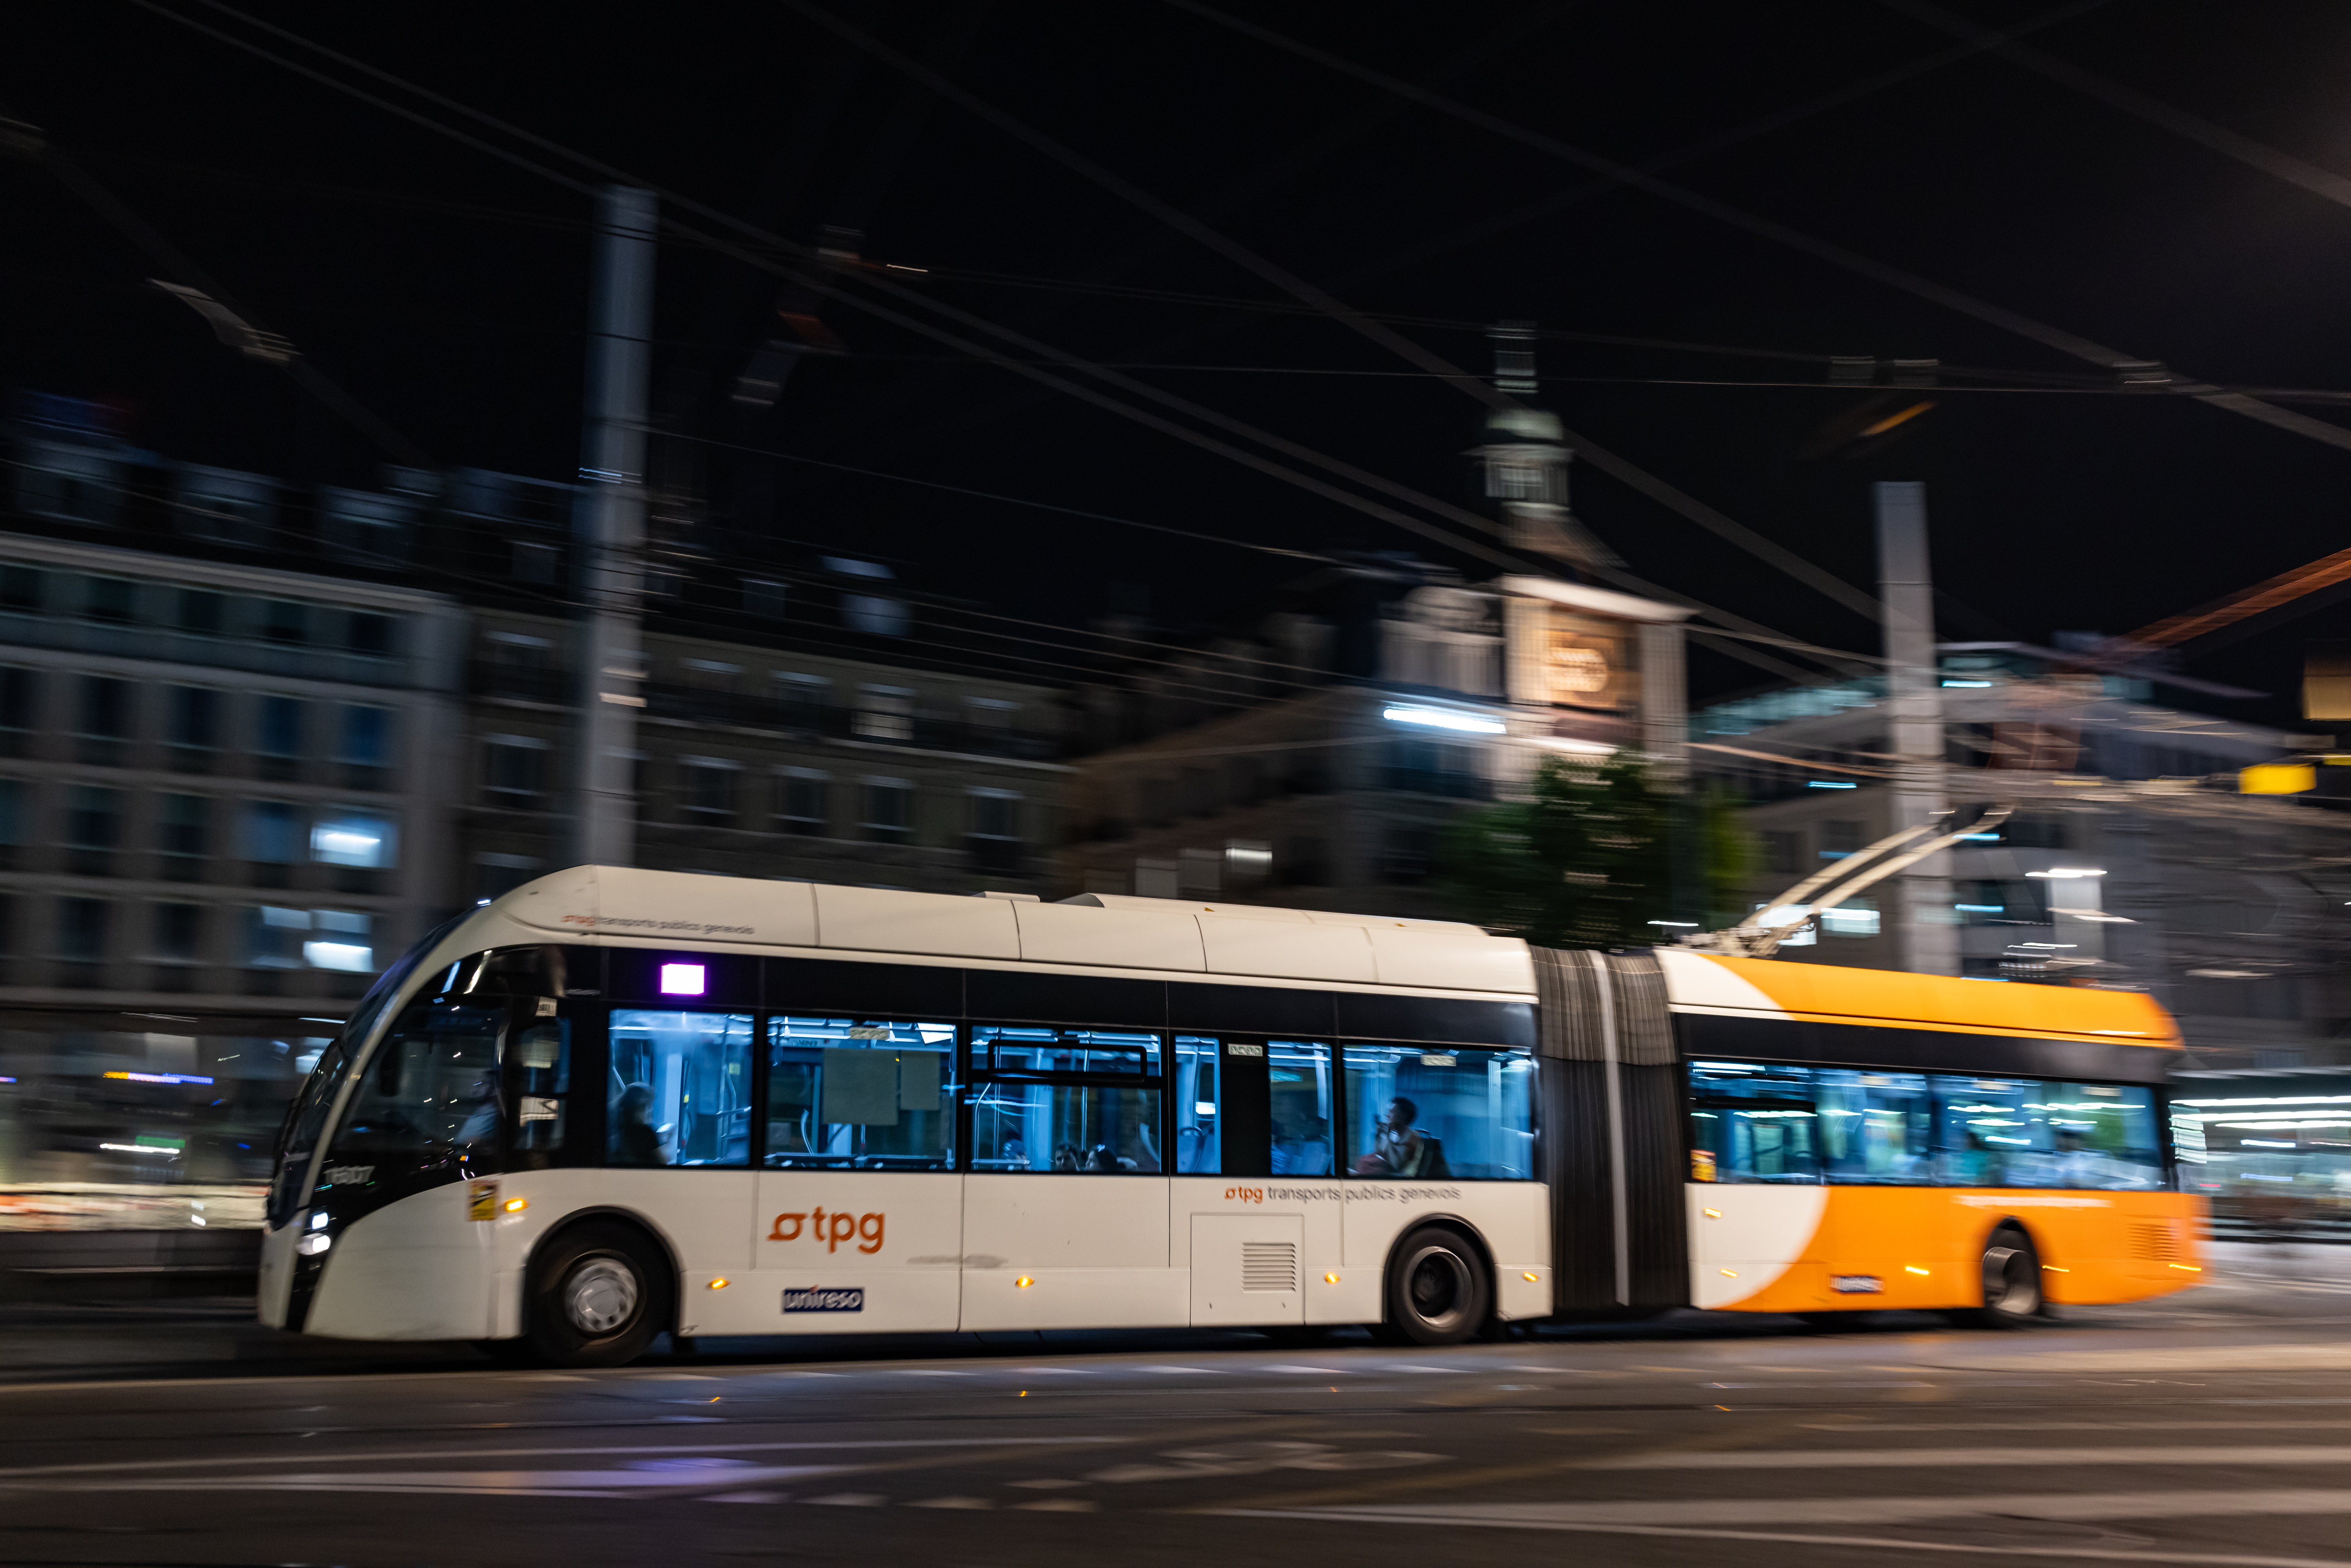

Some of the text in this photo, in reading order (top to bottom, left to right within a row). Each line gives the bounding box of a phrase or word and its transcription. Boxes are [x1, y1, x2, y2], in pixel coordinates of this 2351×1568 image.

[1268, 1185, 1341, 1204] transports
[1344, 1184, 1396, 1205] publics
[1398, 1184, 1462, 1204] genevois
[784, 1284, 862, 1309] unireso
